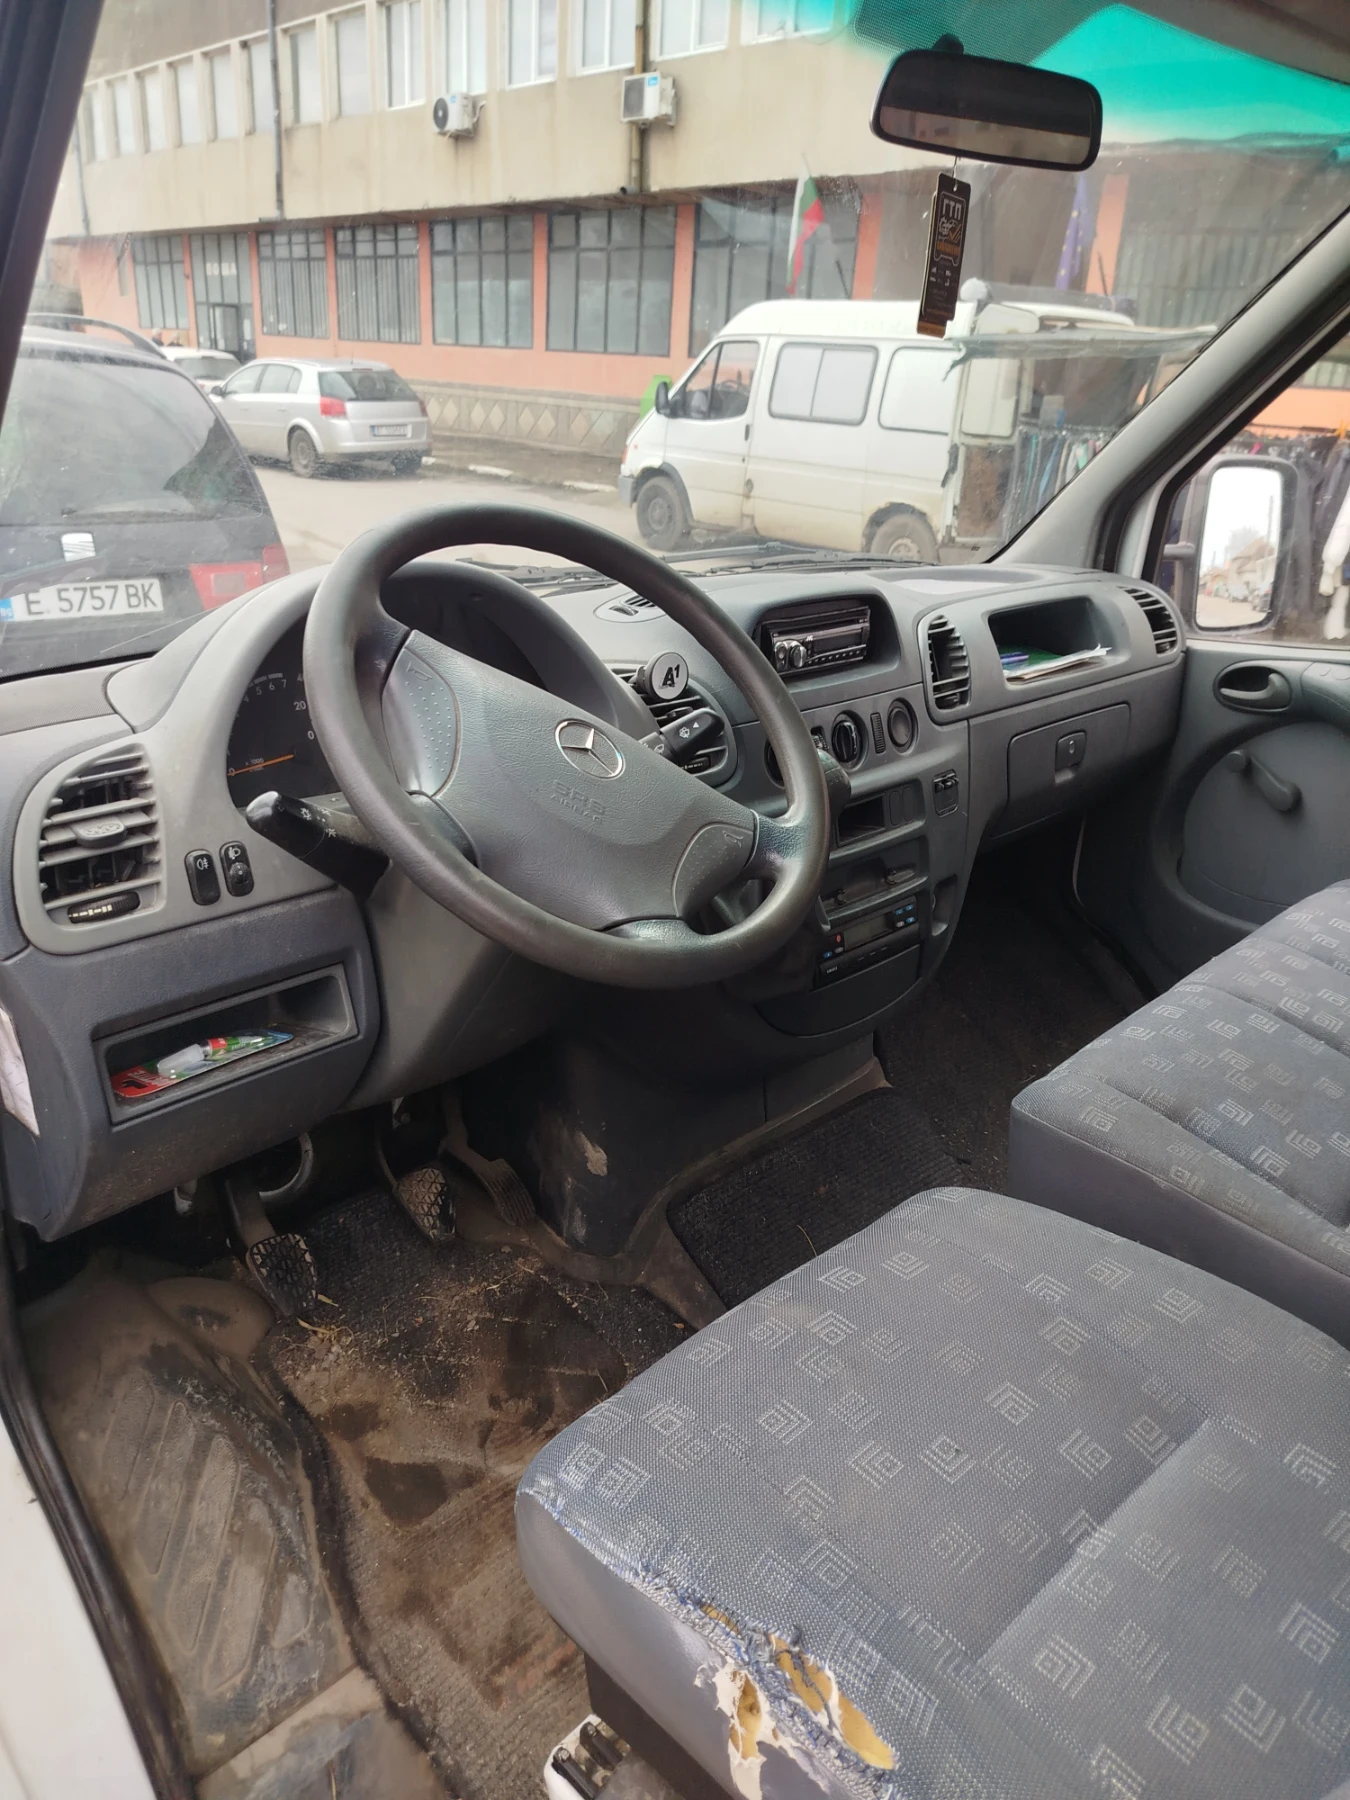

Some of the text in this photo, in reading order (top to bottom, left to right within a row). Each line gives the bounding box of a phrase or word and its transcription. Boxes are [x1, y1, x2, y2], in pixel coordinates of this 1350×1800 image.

[942, 198, 962, 220] ГТП
[25, 583, 157, 615] E 5757 BK
[662, 664, 680, 687] A1
[269, 682, 275, 690] 6
[281, 679, 287, 688] 7
[256, 687, 262, 695] 5
[294, 701, 307, 711] 20
[307, 731, 315, 740] 0
[553, 779, 605, 816] SRS
